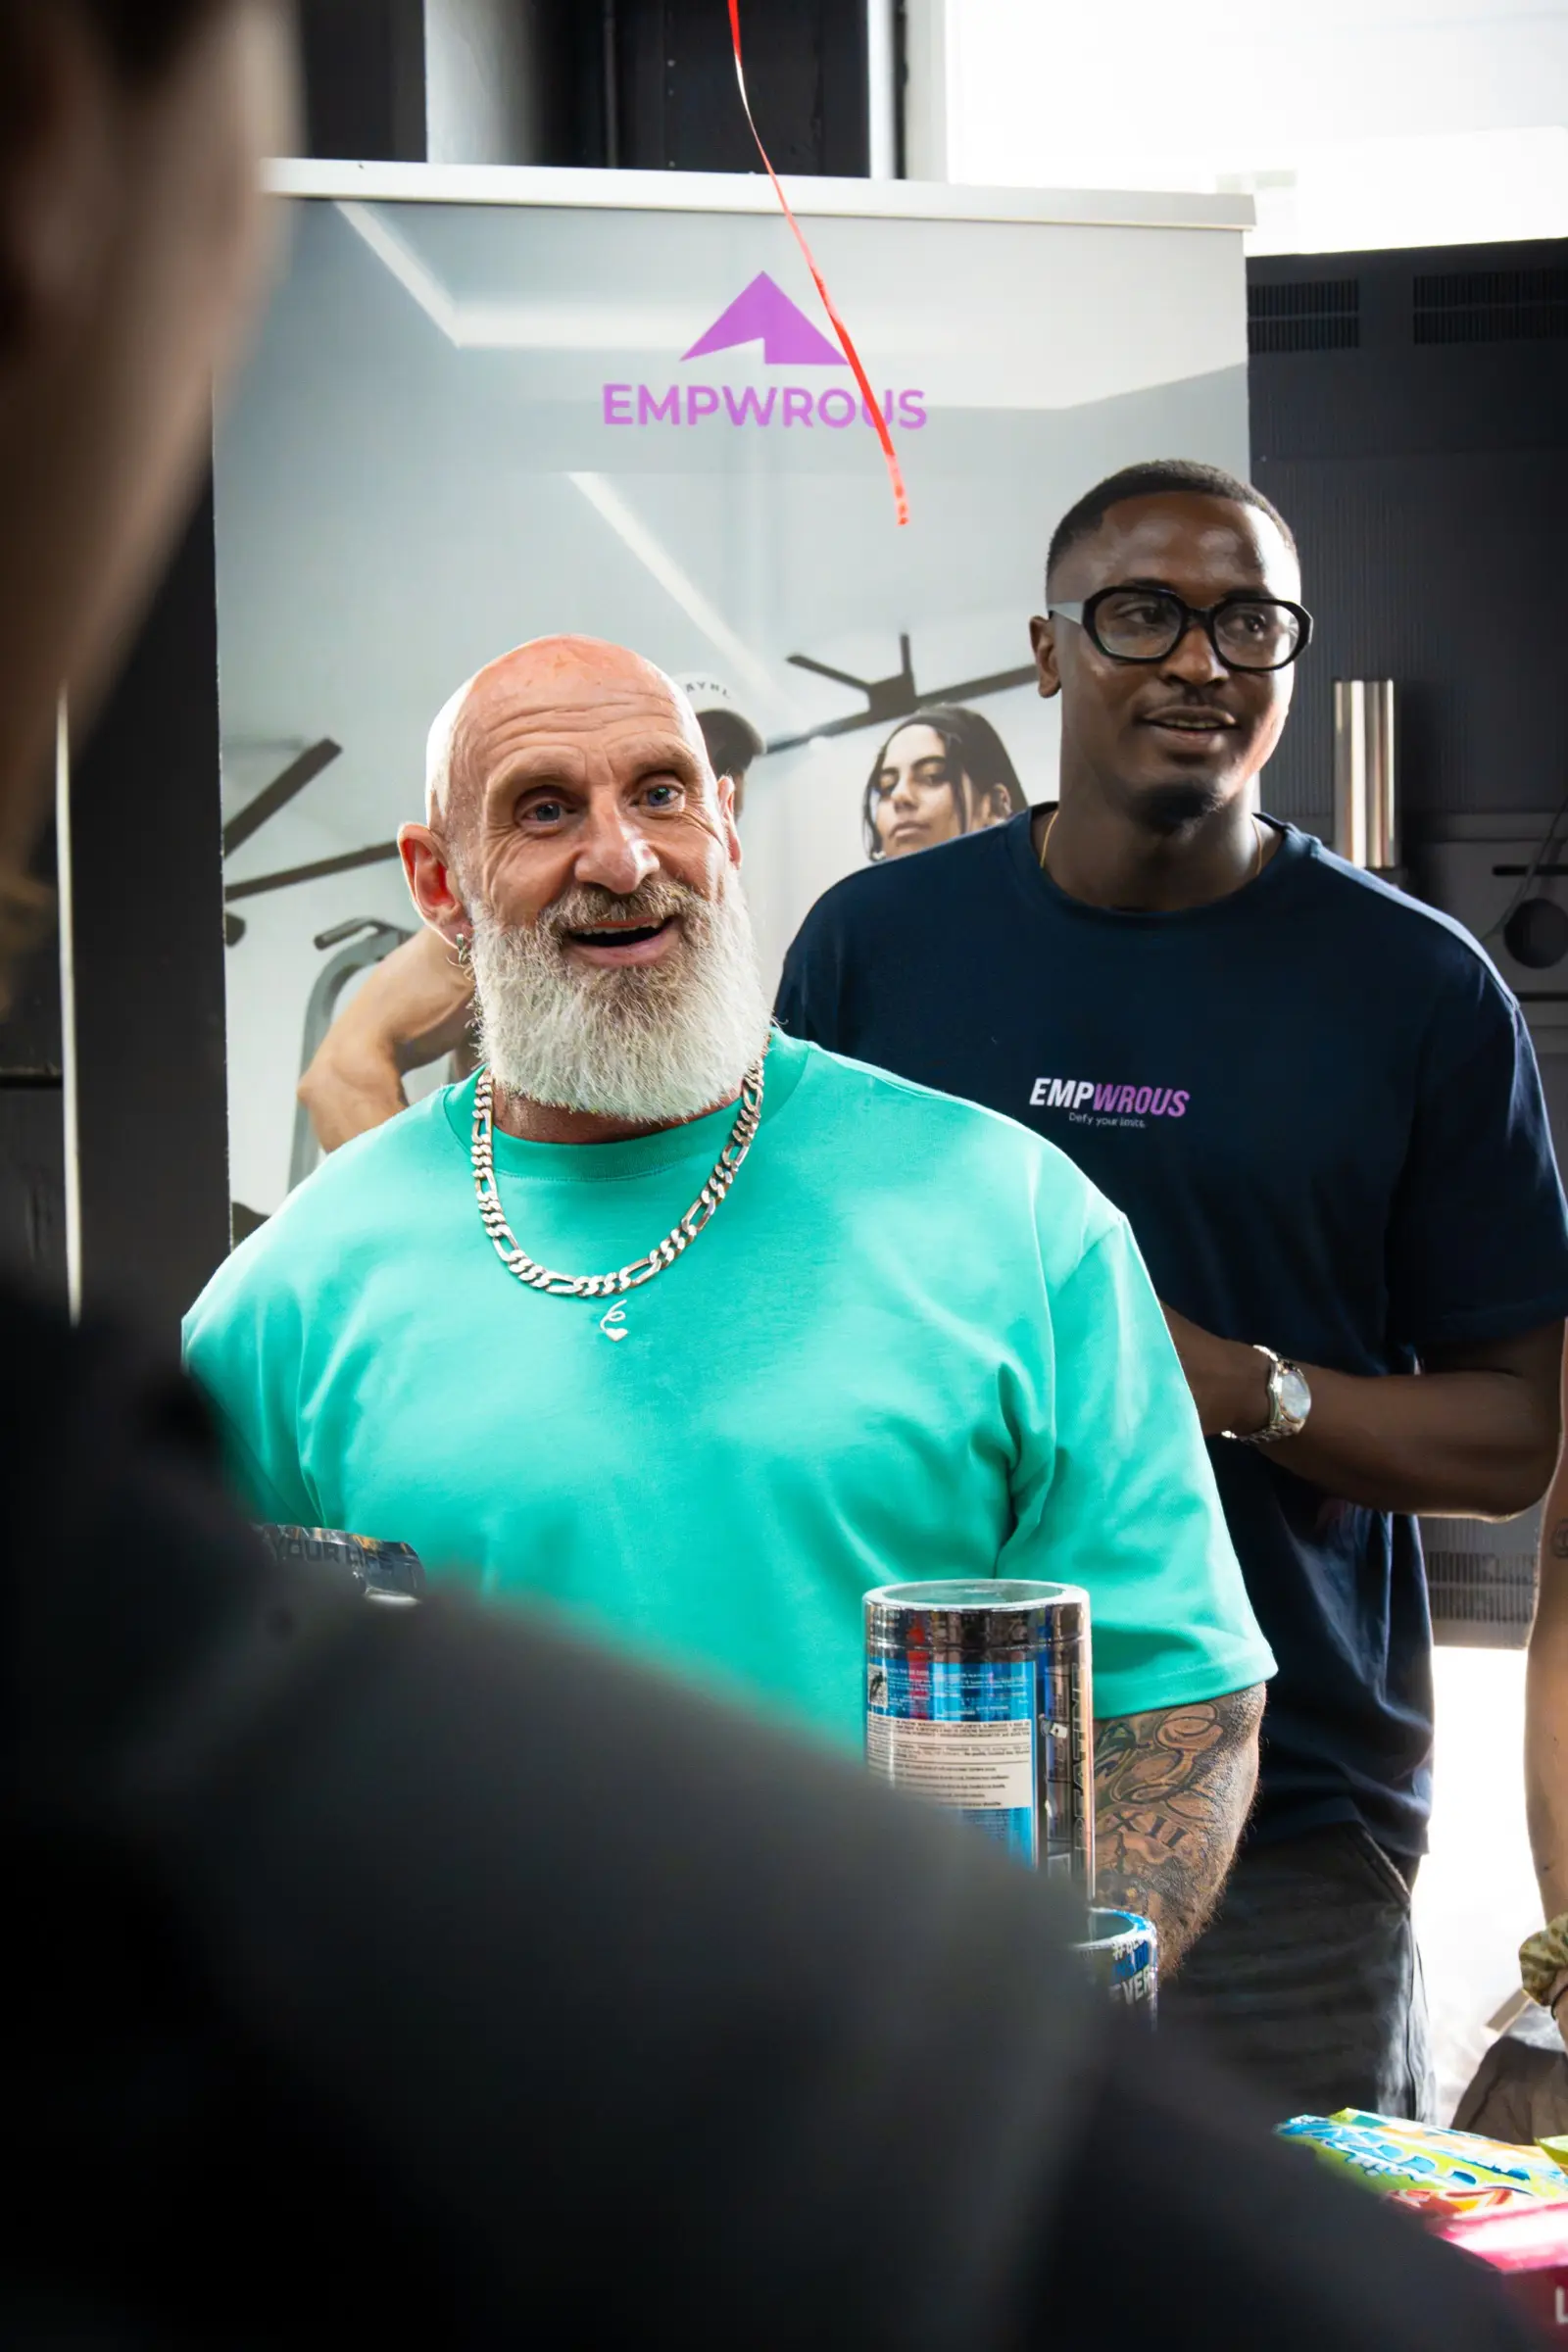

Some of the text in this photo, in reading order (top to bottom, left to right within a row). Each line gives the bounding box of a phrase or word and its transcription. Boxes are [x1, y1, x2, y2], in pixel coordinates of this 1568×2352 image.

[603, 383, 927, 429] EMPWROUS
[1030, 1078, 1190, 1117] EMPWROUS
[1068, 1111, 1094, 1126] Defy
[1096, 1117, 1118, 1127] your
